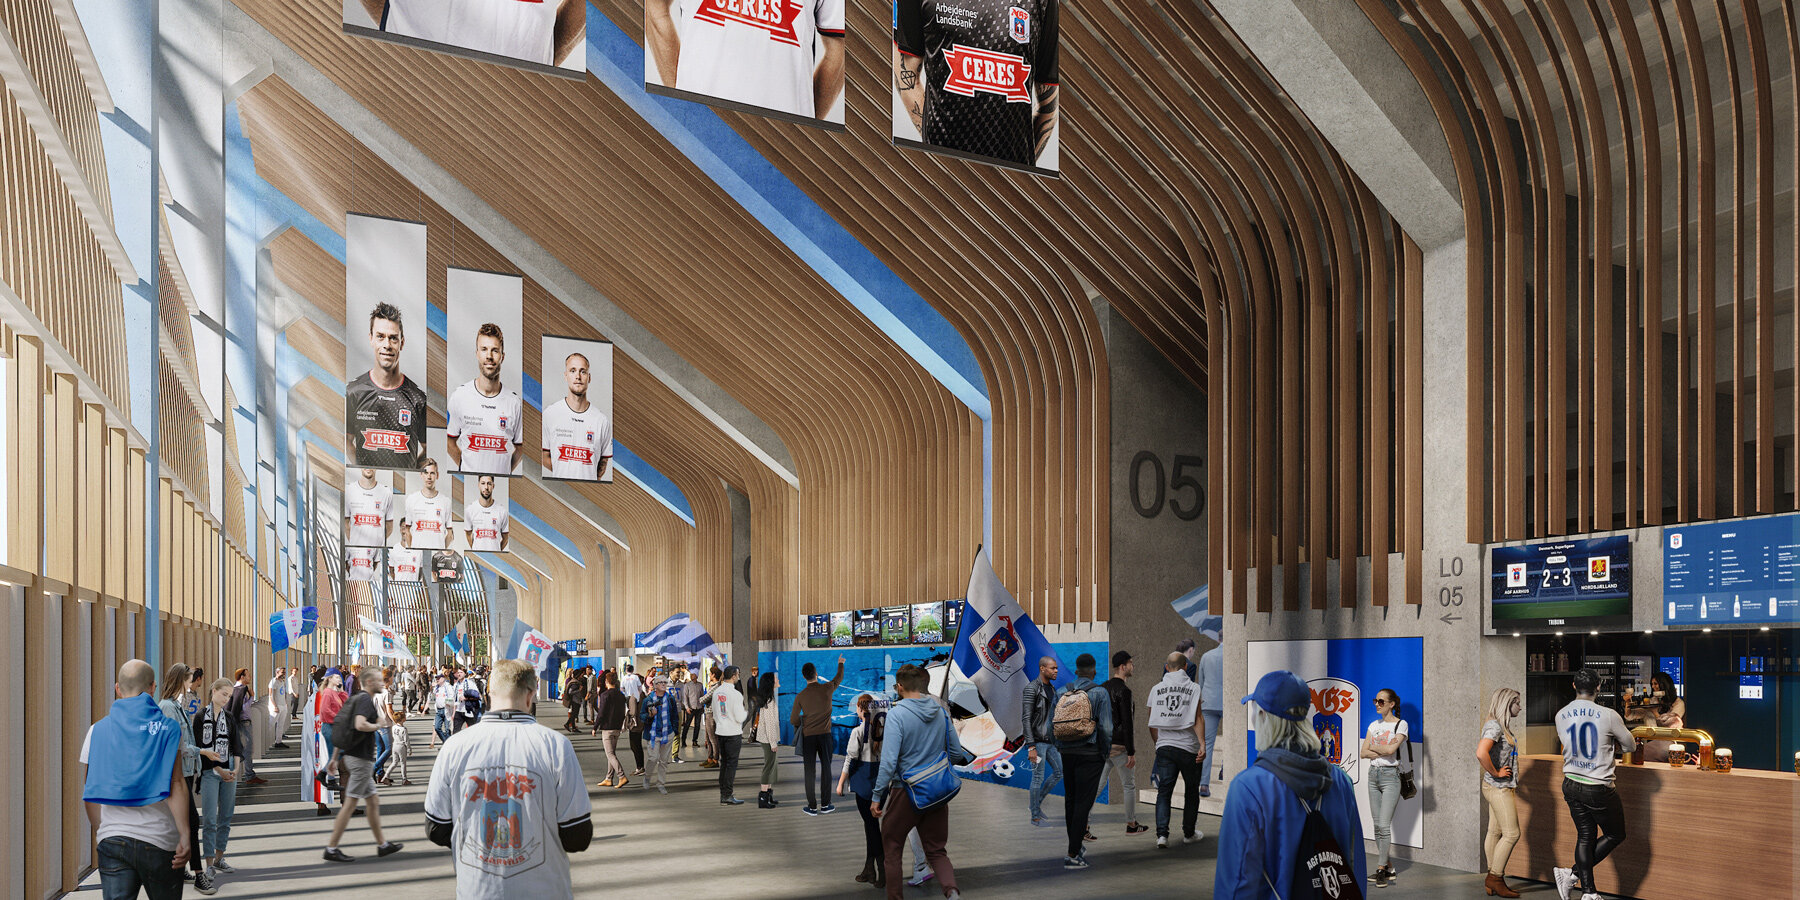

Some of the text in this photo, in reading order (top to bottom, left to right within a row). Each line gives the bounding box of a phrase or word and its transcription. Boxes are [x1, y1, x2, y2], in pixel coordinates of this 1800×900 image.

[936, 3, 978, 19] Arbejdernes
[936, 14, 973, 29] Landsbank
[962, 56, 1015, 87] CERES
[371, 433, 401, 446] CERES
[474, 437, 501, 448] CERES
[565, 447, 587, 459] CERES
[1128, 450, 1205, 521] 05
[357, 515, 377, 524] CERES
[420, 521, 438, 529] CERES
[1542, 569, 1551, 588] 2
[1562, 567, 1571, 586] 3
[1439, 586, 1463, 607] 05
[1157, 686, 1193, 695] AGF AARHUS
[1561, 708, 1602, 720] AARHUS
[1566, 721, 1599, 760] 10
[1306, 851, 1343, 870] AGF AARHUS
